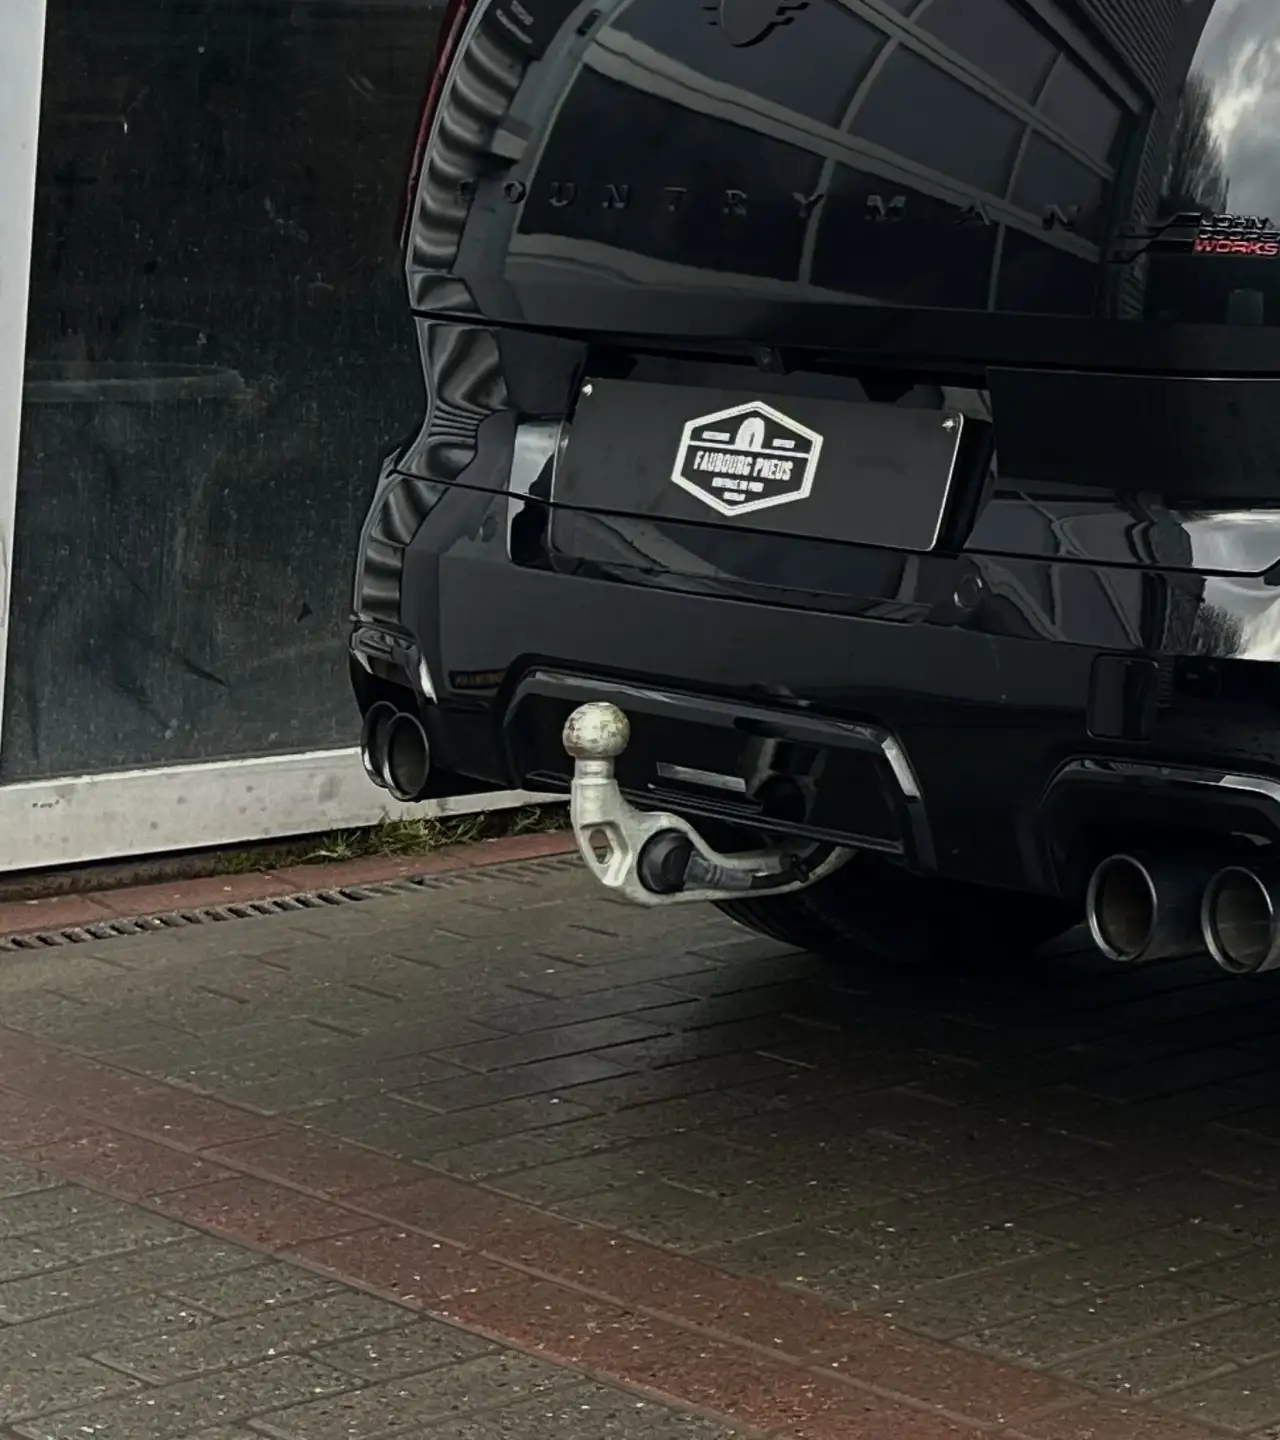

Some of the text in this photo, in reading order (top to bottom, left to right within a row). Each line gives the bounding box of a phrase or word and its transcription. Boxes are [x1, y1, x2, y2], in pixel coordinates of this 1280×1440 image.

[456, 178, 1080, 231] COUNTRYMAN
[1200, 213, 1273, 229] JOHN
[1195, 240, 1279, 256] WORKS
[693, 450, 794, 481] FAUBOURG PNEUS
